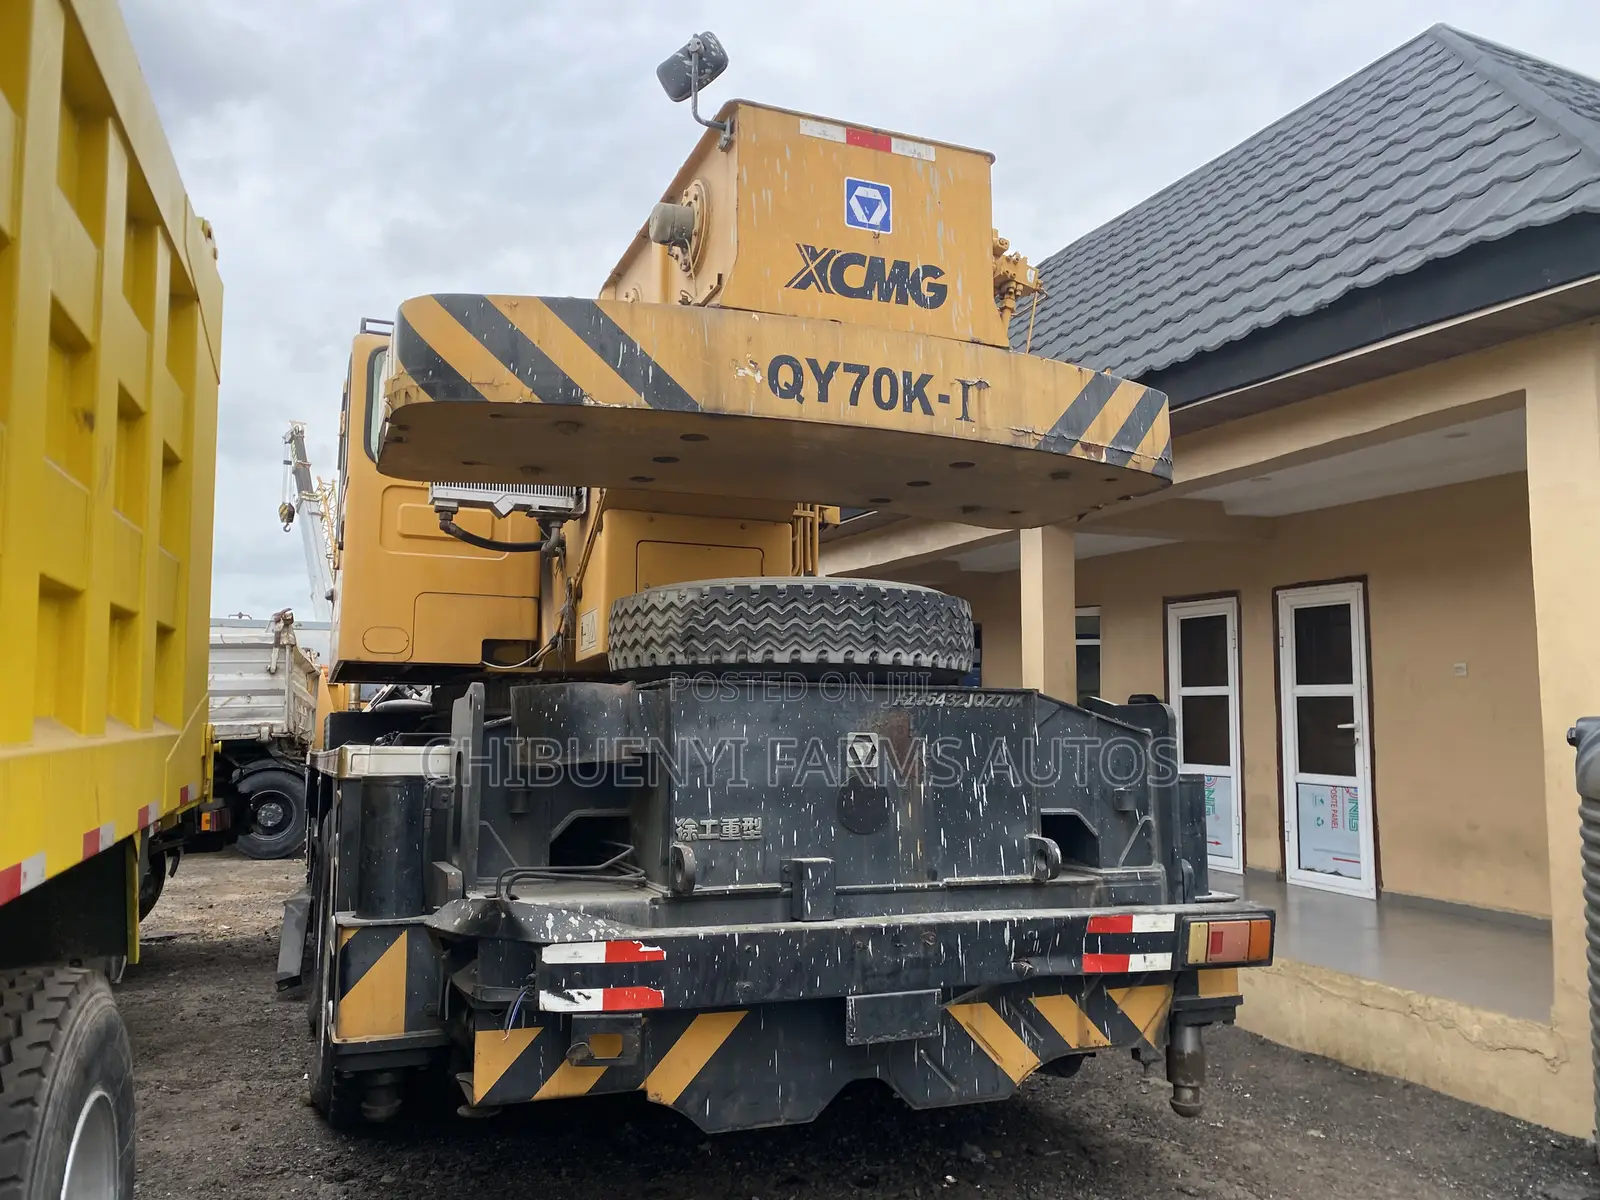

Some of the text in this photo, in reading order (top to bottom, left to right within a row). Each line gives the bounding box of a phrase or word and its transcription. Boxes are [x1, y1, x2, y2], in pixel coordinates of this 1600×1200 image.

[785, 242, 948, 310] XCMG
[674, 816, 763, 842] 徐工重型
